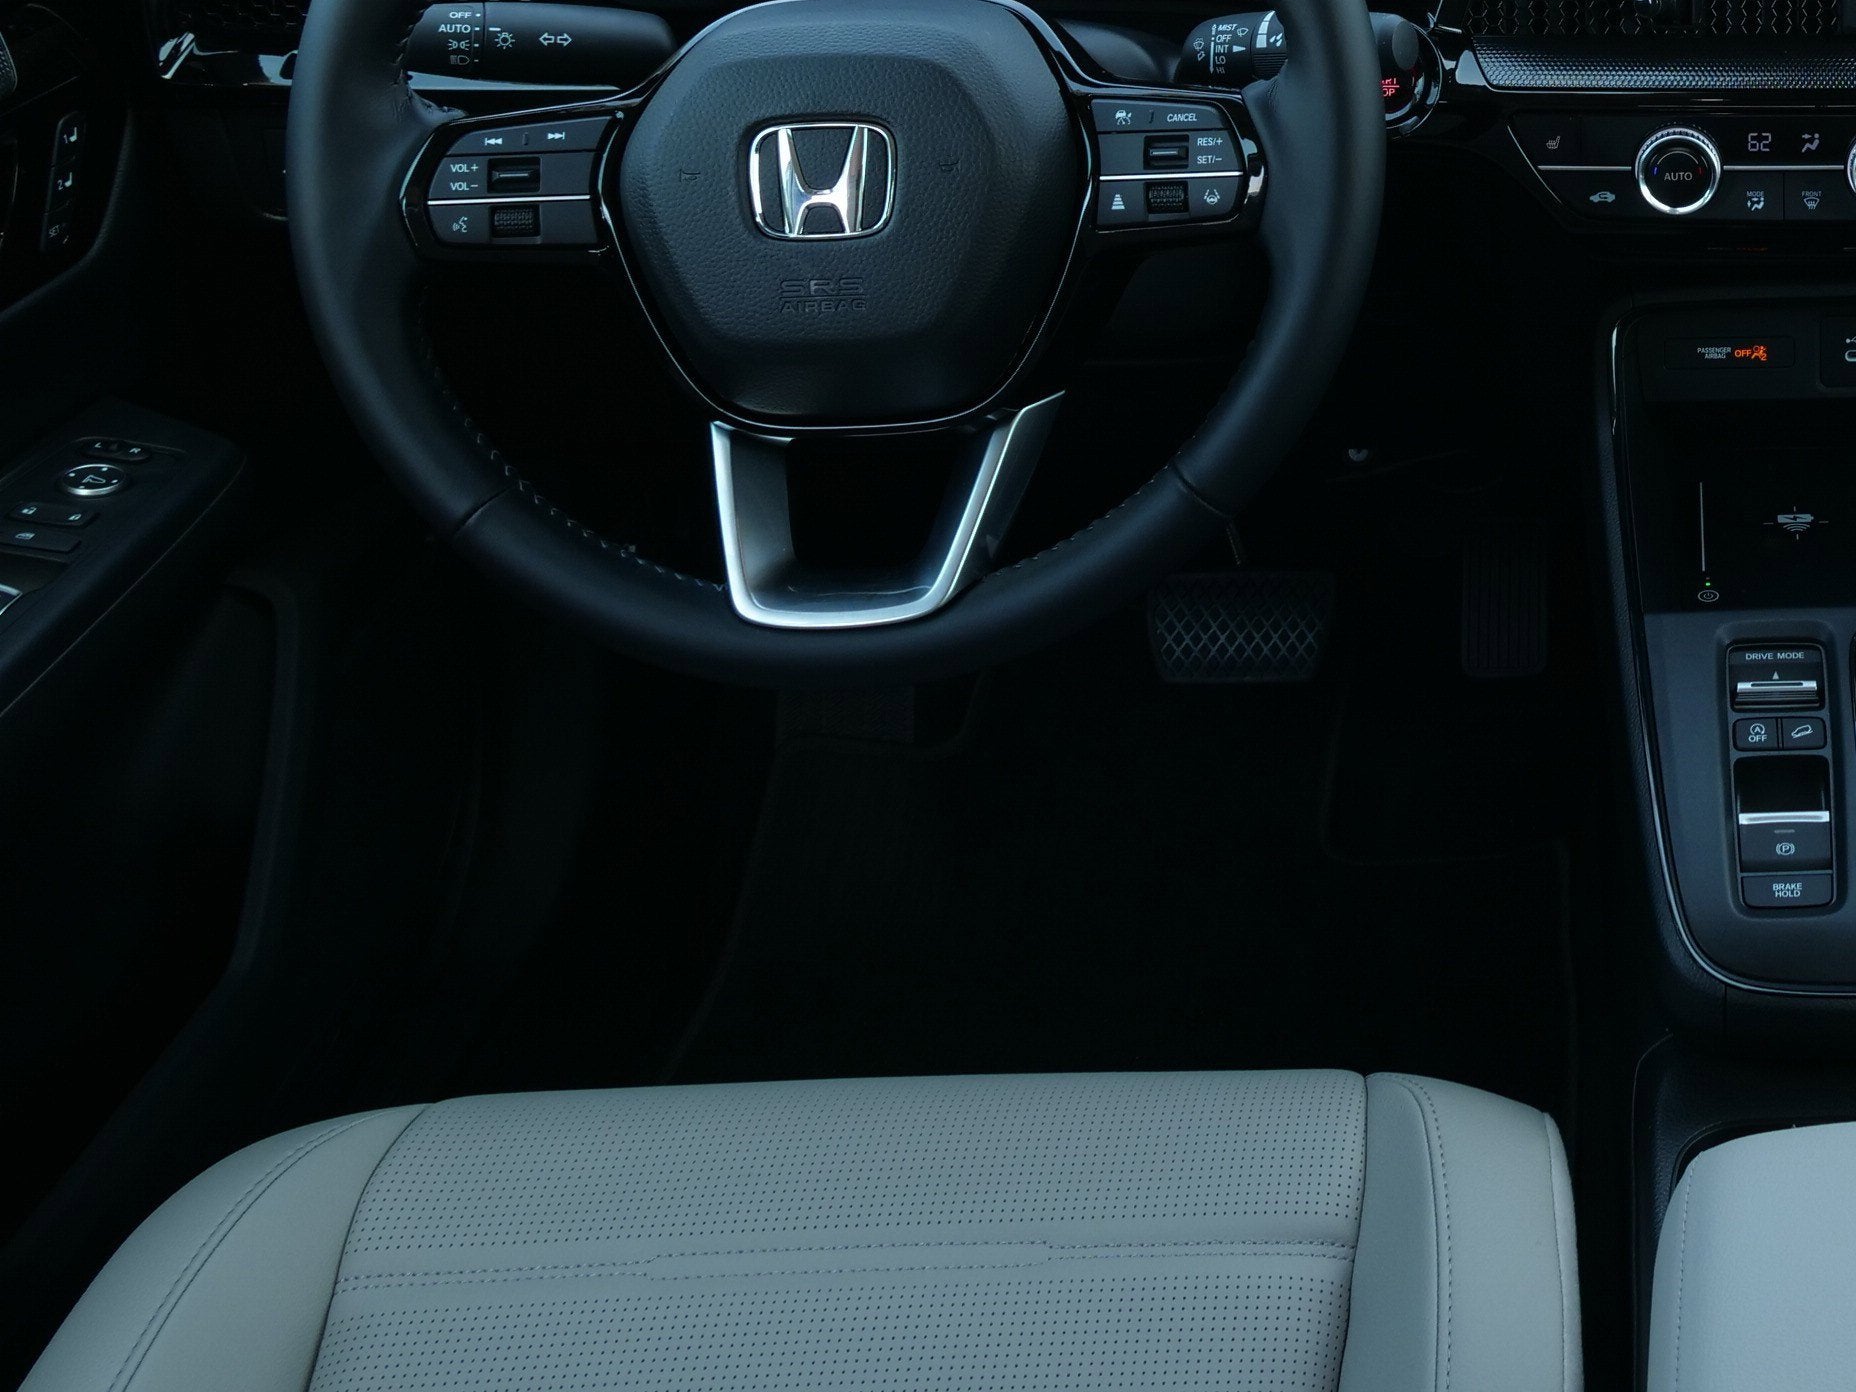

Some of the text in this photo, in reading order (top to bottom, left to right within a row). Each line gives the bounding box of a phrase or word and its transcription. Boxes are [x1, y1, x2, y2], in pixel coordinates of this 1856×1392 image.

[438, 24, 471, 33] AUTO
[1218, 23, 1237, 31] MIST
[1215, 34, 1231, 43] OFF
[1215, 44, 1229, 53] INT
[1215, 56, 1226, 65] LO
[1166, 112, 1197, 122] CANCEL
[1197, 137, 1222, 146] RES/+
[1748, 133, 1772, 152] 62
[1664, 172, 1693, 181] AUTO
[780, 277, 864, 295] SRS
[780, 298, 867, 312] AIRBAG
[1697, 346, 1731, 354] PASSENGER
[1734, 348, 1752, 358] OFF
[1745, 651, 1805, 660] DRIVE MODE
[1748, 734, 1768, 743] OFF
[1772, 882, 1803, 891] BRAKE
[1775, 889, 1801, 898] HOLD
